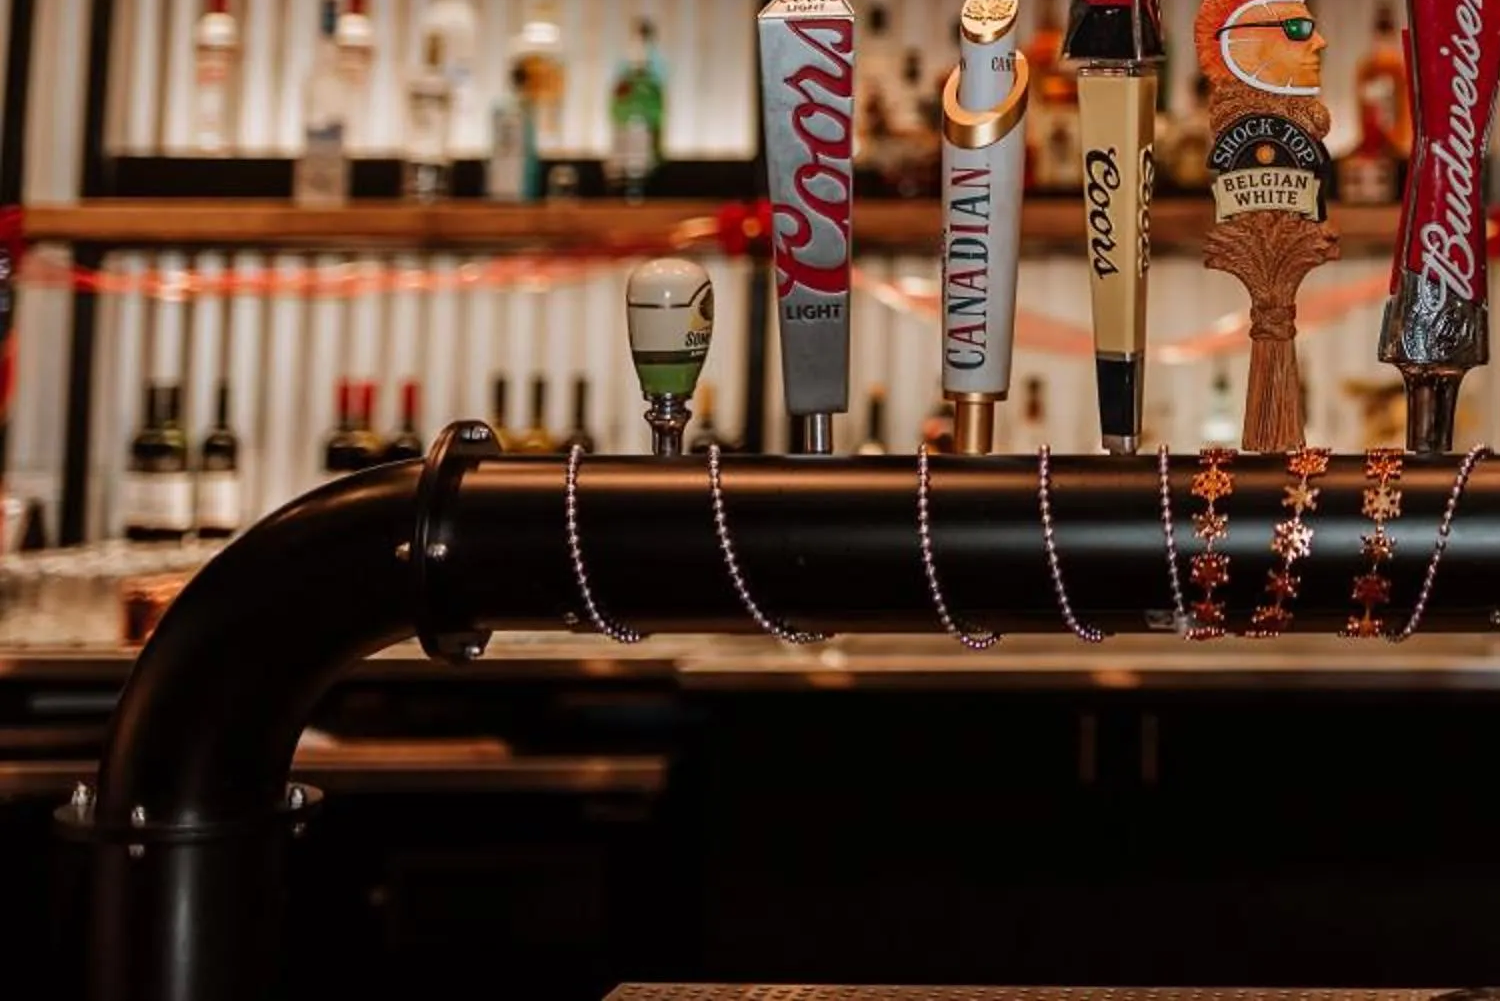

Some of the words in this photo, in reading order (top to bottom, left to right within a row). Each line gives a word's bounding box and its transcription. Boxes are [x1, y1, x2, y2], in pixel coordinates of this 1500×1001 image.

[772, 19, 853, 299] Coors
[1213, 118, 1274, 168] SHOCK
[1282, 124, 1315, 166] TOP
[1223, 173, 1308, 192] BELGIAN
[1234, 189, 1298, 206] WHITE
[1085, 147, 1120, 280] Coors
[945, 167, 992, 370] CANADIAN
[785, 304, 842, 321] LIGHT
